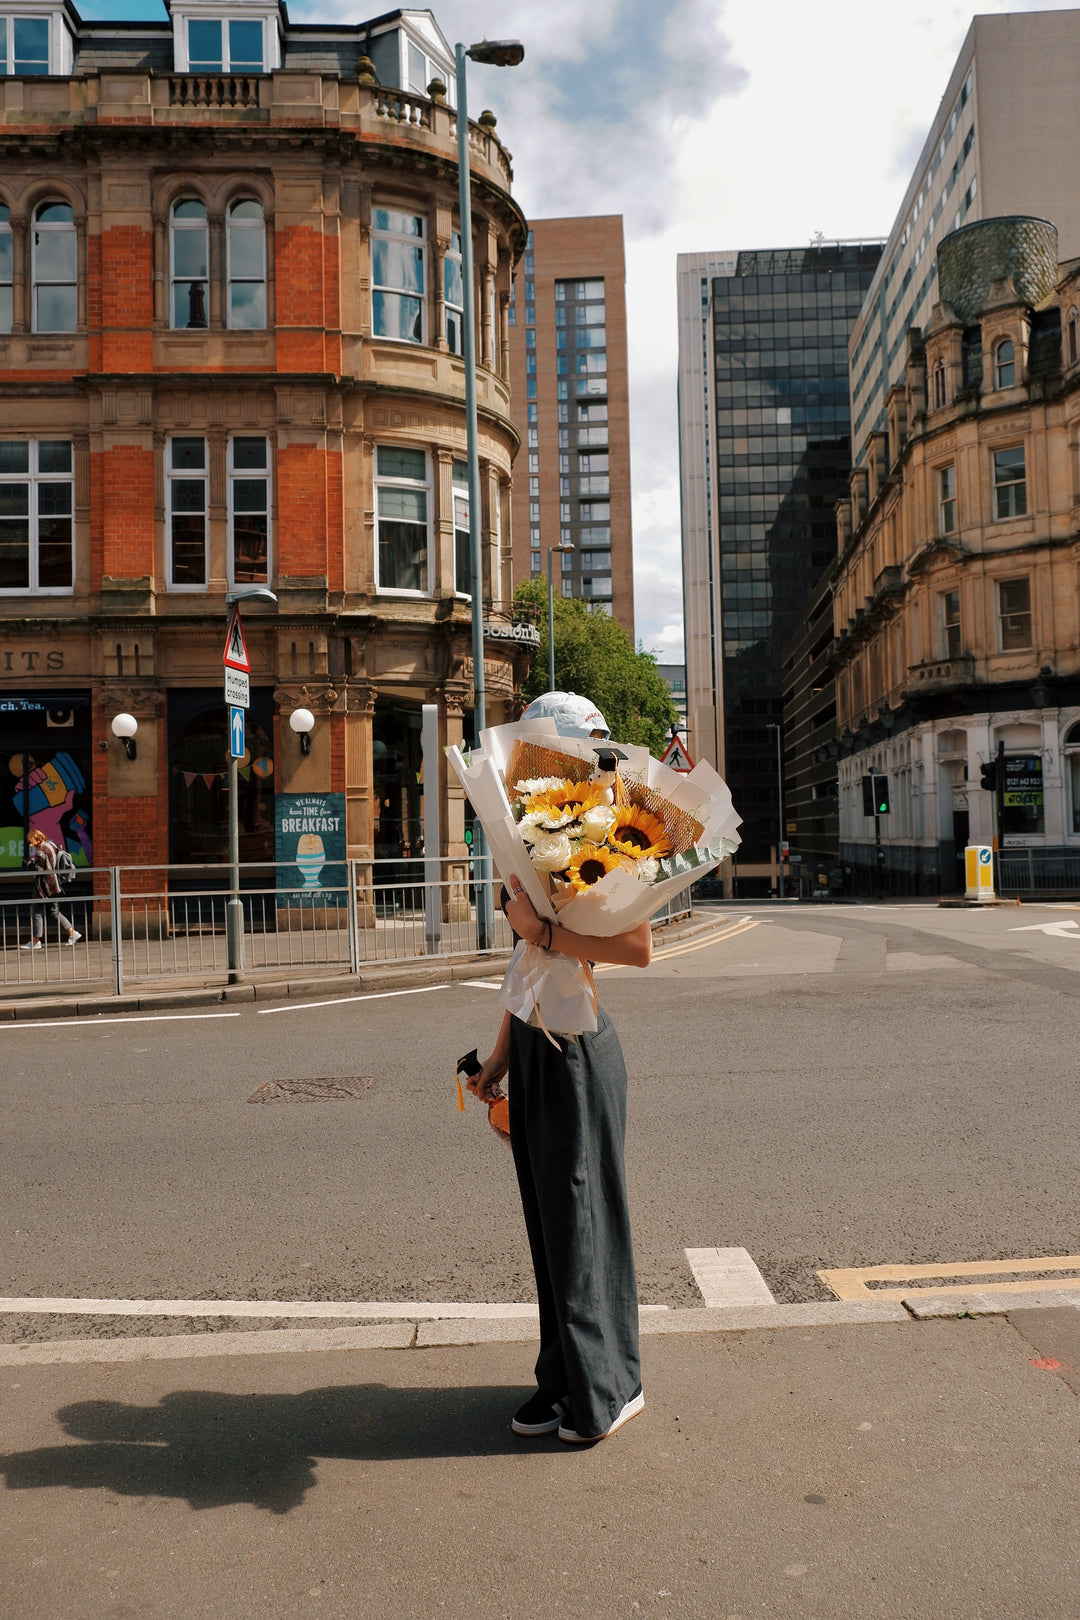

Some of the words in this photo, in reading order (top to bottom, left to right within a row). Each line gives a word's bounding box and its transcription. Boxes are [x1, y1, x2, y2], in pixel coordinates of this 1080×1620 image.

[4, 651, 65, 671] ITS
[227, 672, 248, 688] Humped
[227, 689, 248, 704] crossing
[20, 701, 45, 710] Tea.
[295, 799, 304, 807] WE
[305, 798, 327, 807] ALWAYS
[303, 806, 319, 816] TIME
[320, 807, 332, 816] for
[281, 817, 340, 833] BREAKFAST
